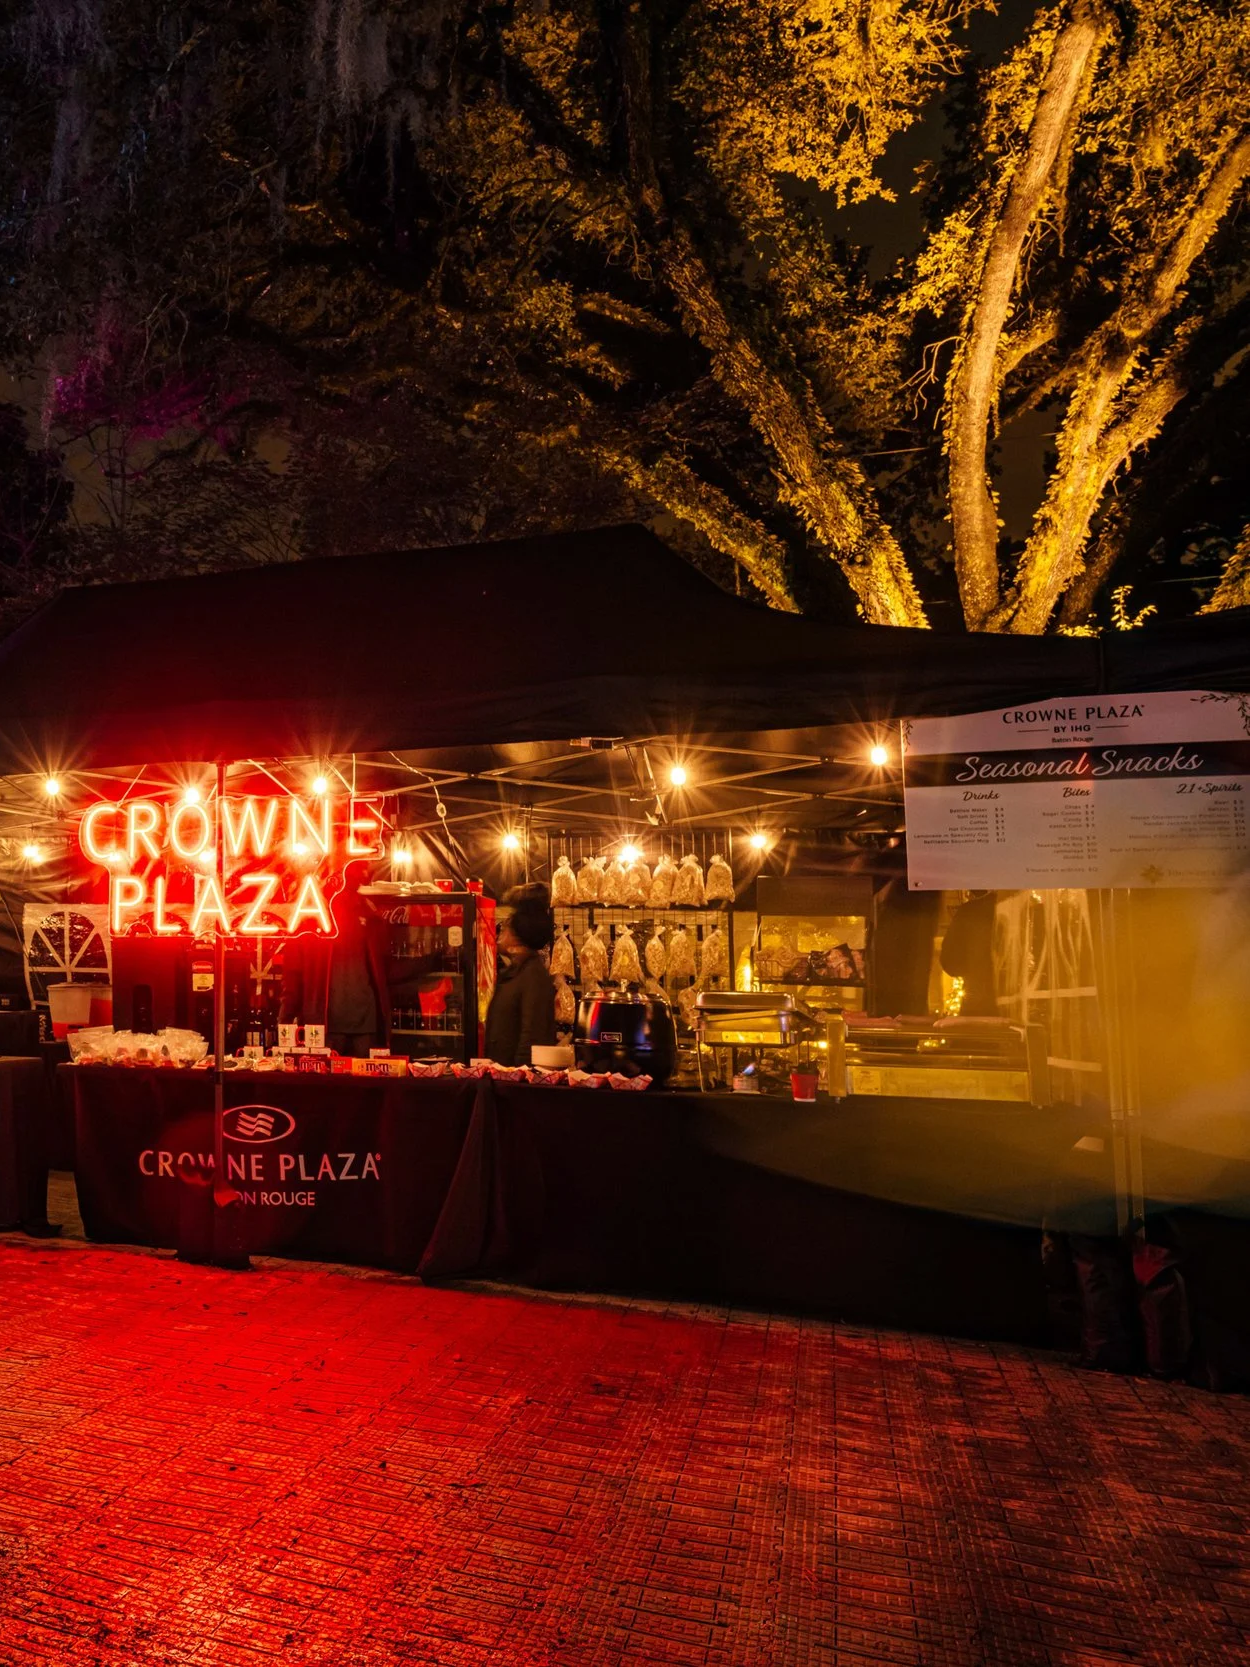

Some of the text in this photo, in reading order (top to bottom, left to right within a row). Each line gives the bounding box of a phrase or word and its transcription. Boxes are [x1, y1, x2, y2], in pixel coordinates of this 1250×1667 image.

[1002, 703, 1143, 724] CROWNE PLAZA
[1053, 724, 1092, 734] BY IHG
[956, 746, 1204, 782] Seasonal Snacks
[962, 789, 1000, 802] Drinks
[1062, 786, 1092, 798] Bites
[83, 796, 380, 860] CROWNE
[113, 874, 331, 934] PLAZA
[279, 1152, 380, 1182] PLAZA
[260, 1191, 316, 1206] ROUGE
